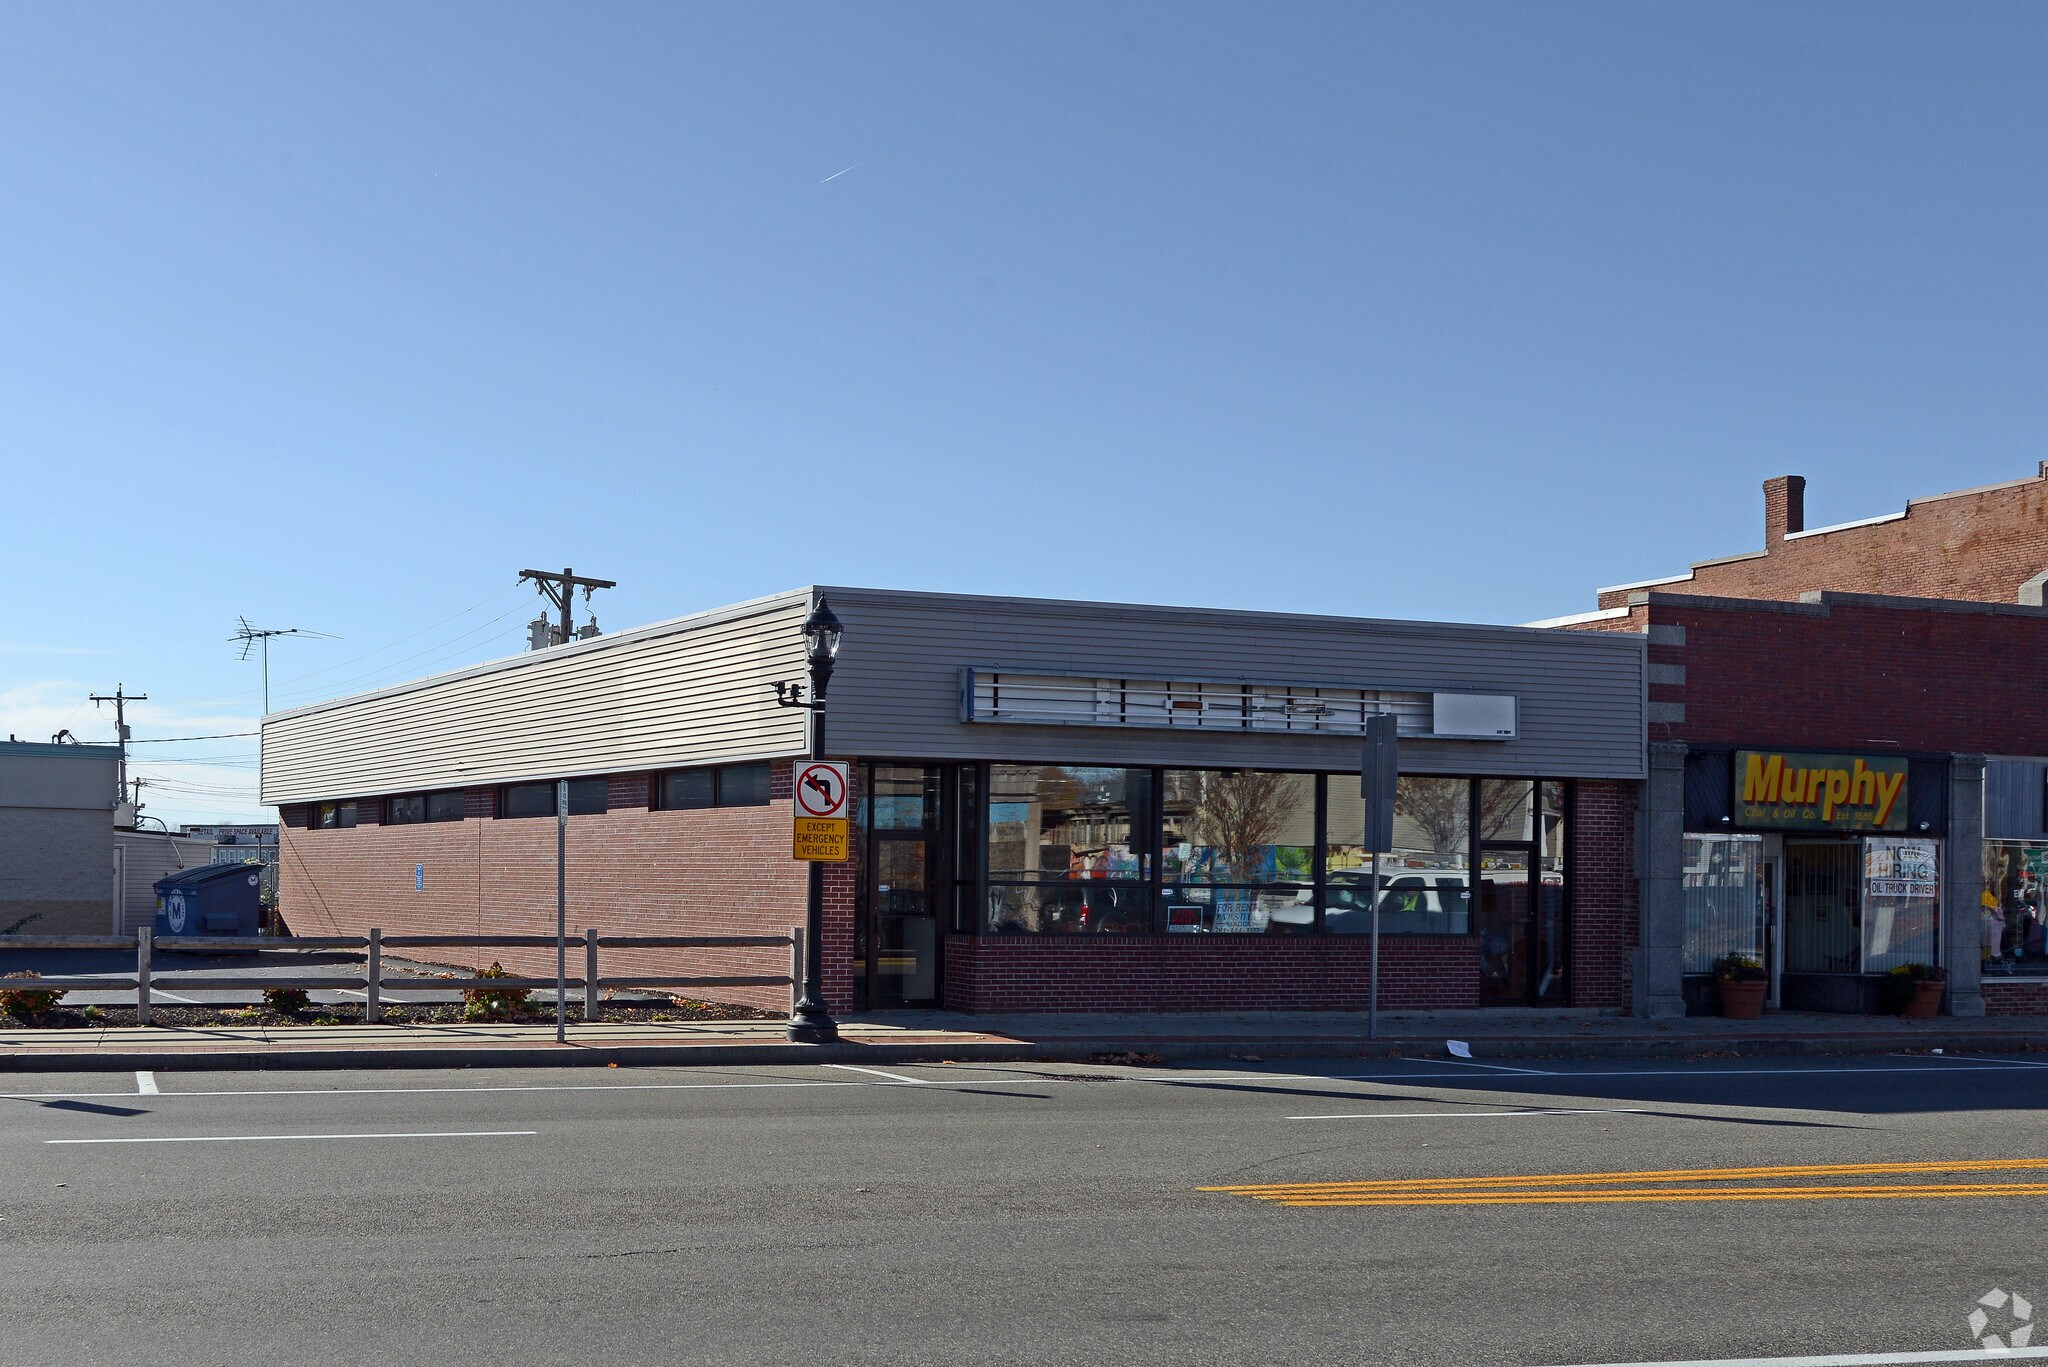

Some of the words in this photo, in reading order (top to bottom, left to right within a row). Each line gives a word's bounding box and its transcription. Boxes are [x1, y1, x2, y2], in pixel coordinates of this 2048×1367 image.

[1743, 754, 1906, 828] Murphy
[1744, 808, 1766, 818] Coal
[1772, 808, 1780, 818] &
[1783, 808, 1796, 819] Oil
[1802, 809, 1817, 819] Co.
[1854, 811, 1873, 821] 1886
[233, 828, 248, 836] SPACE
[806, 822, 836, 832] EXCEPT
[796, 833, 845, 844] EMERGENCY
[801, 845, 840, 856] VEHICLES
[1871, 882, 1883, 894] OIL
[1885, 882, 1907, 894] TRUCK
[1909, 883, 1935, 894] DRIVER
[172, 902, 182, 920] M
[1217, 903, 1233, 913] FOR
